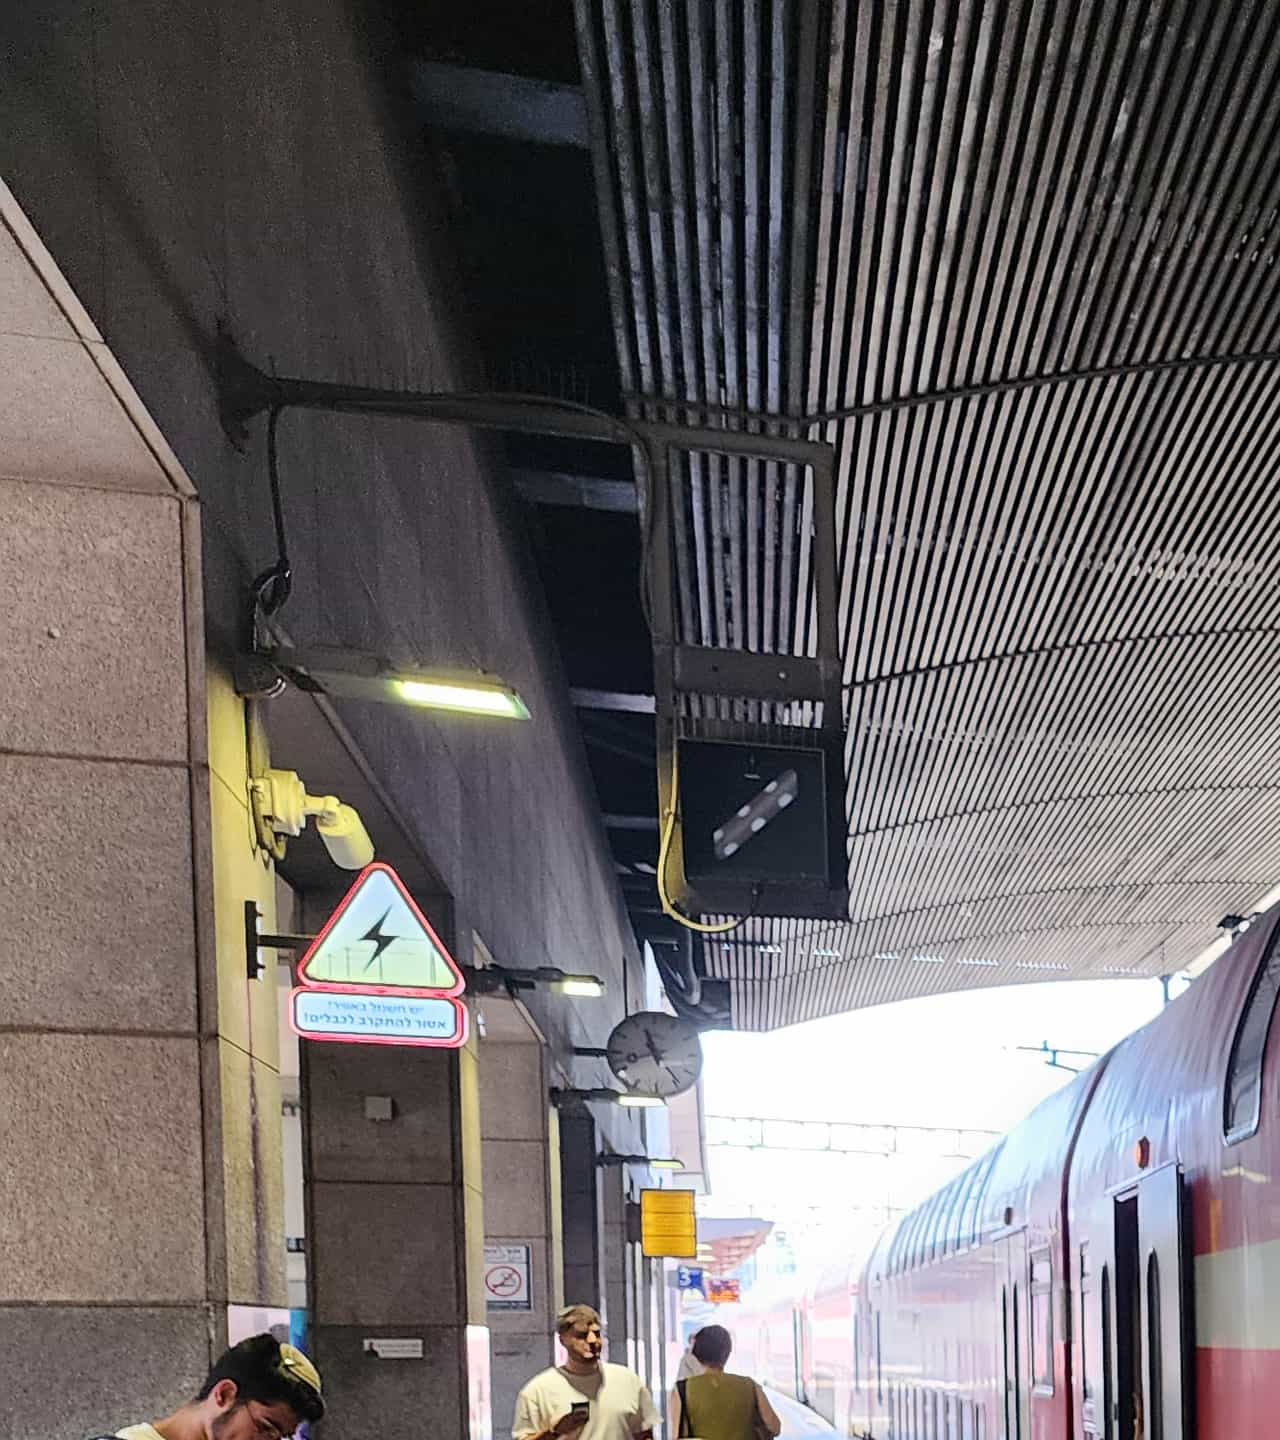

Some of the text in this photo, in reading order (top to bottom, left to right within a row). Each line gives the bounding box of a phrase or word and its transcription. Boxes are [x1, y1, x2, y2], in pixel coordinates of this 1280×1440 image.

[304, 1011, 447, 1030] אסור להתקרב לכבלים!
[679, 1266, 691, 1286] 3
